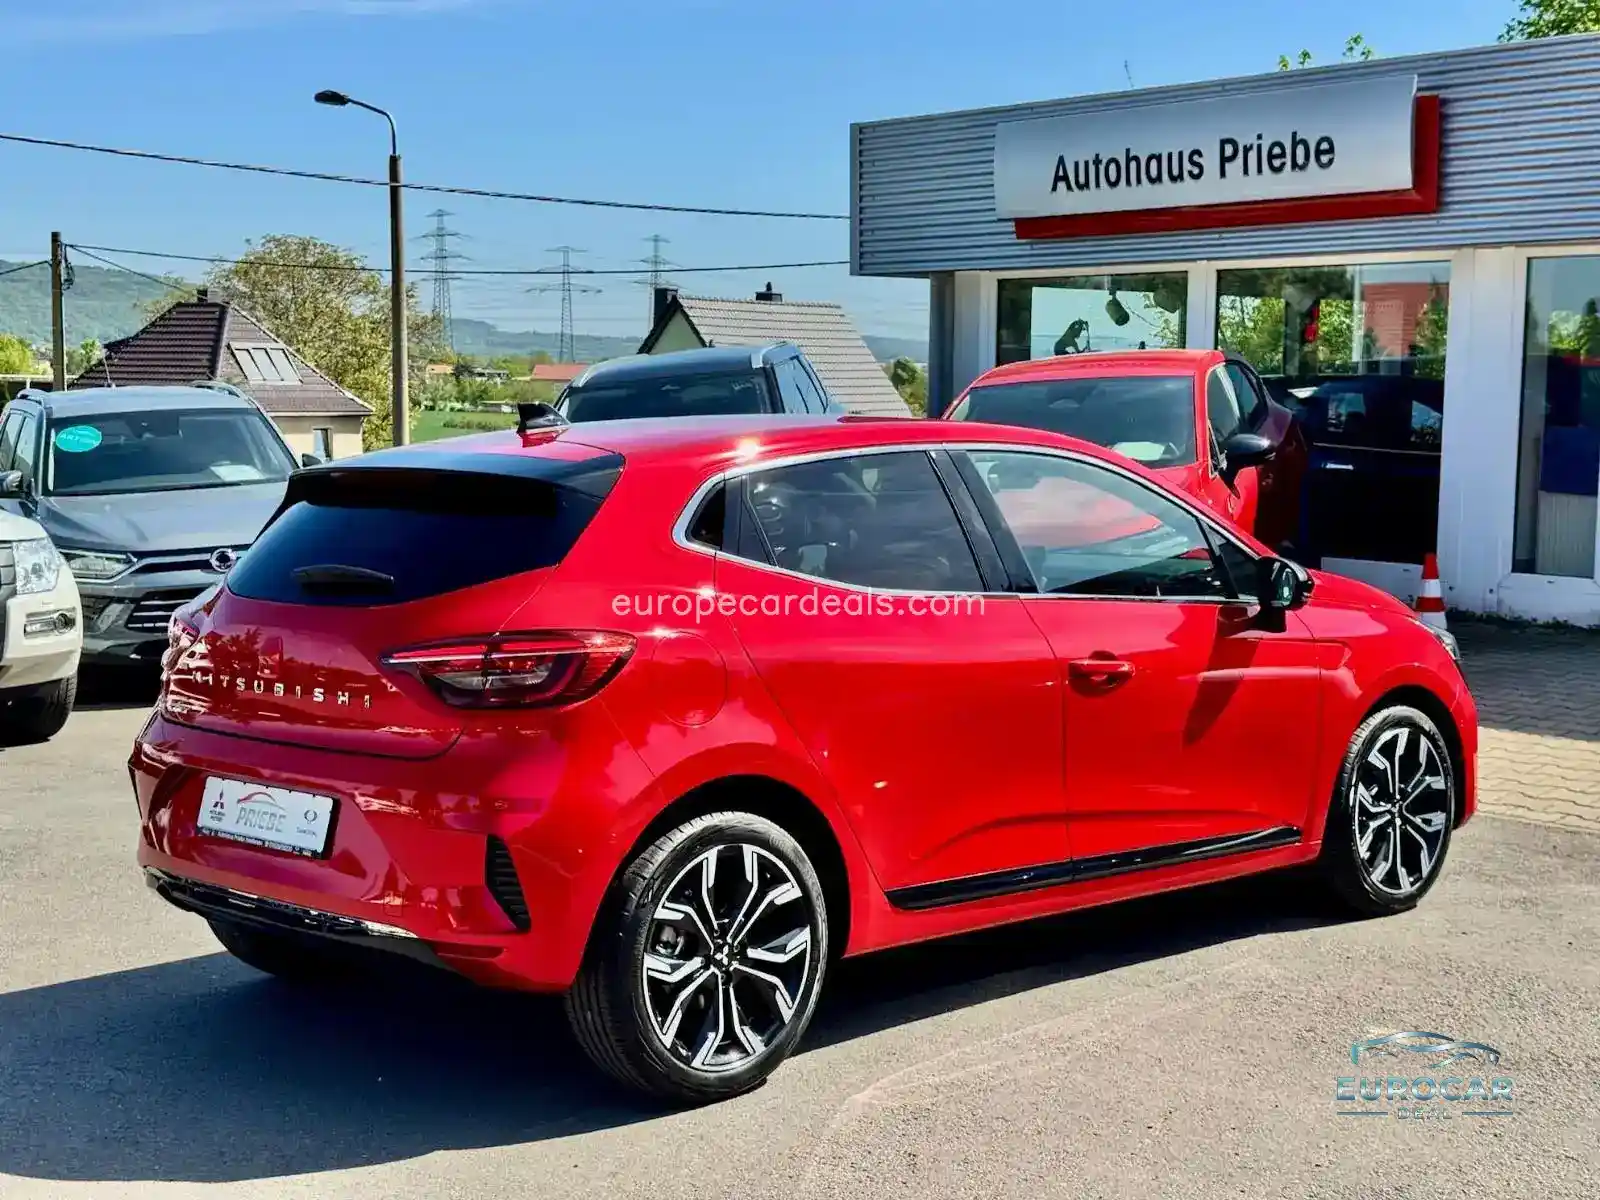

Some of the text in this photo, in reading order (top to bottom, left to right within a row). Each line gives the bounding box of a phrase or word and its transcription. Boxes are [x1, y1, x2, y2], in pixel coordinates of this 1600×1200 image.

[1050, 130, 1335, 193] Autohaus Priebe
[192, 670, 371, 710] MITSUBISHI
